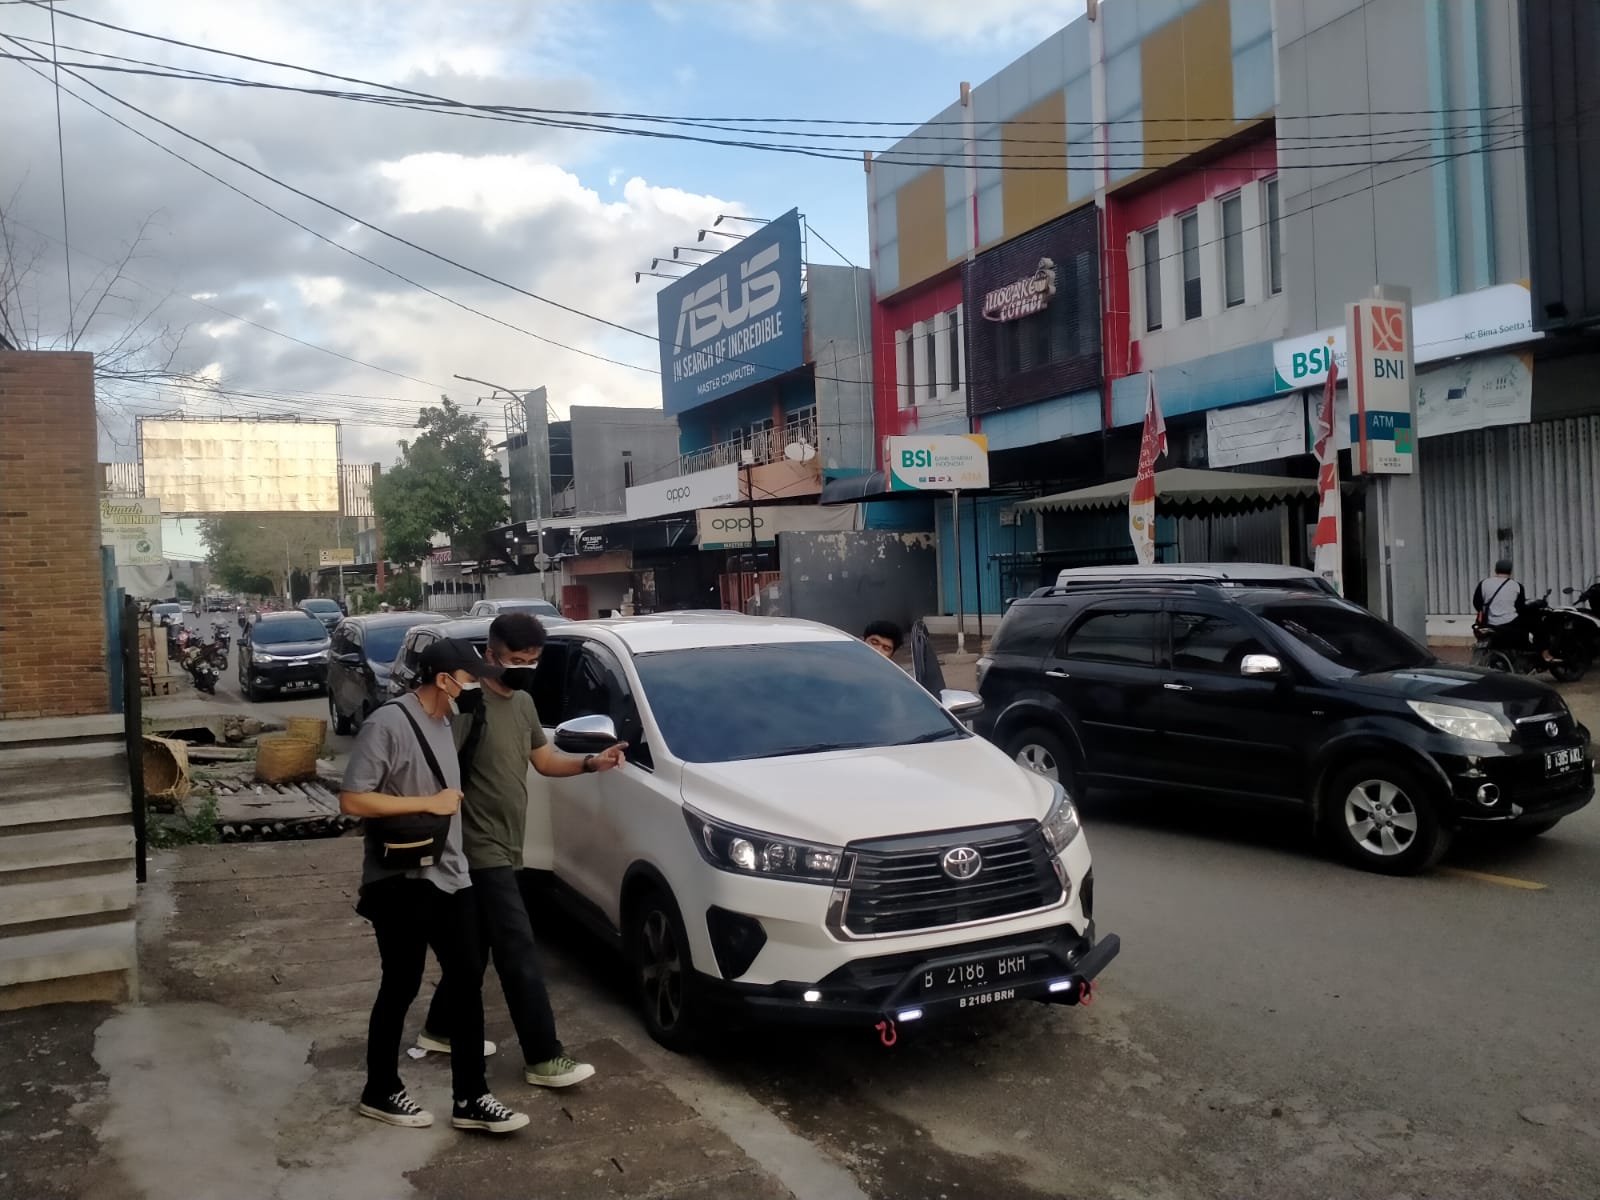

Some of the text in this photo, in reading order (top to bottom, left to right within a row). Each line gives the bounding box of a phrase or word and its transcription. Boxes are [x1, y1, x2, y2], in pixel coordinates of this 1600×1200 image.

[674, 242, 781, 355] ASUS
[1477, 327, 1497, 339] Bima
[673, 311, 783, 383] IN SEARCH OF INCREDIBLE
[1292, 345, 1330, 379] BSI
[1374, 358, 1404, 379] BNI
[697, 364, 756, 396] MASTER COMPUTER
[1372, 415, 1394, 428] ATM
[902, 449, 932, 468] BSI
[666, 486, 690, 503] oppo
[712, 517, 764, 533] oppo
[947, 962, 985, 984] 2186
[998, 955, 1026, 975] BRH
[959, 989, 1015, 1008] B 2186 BRH
